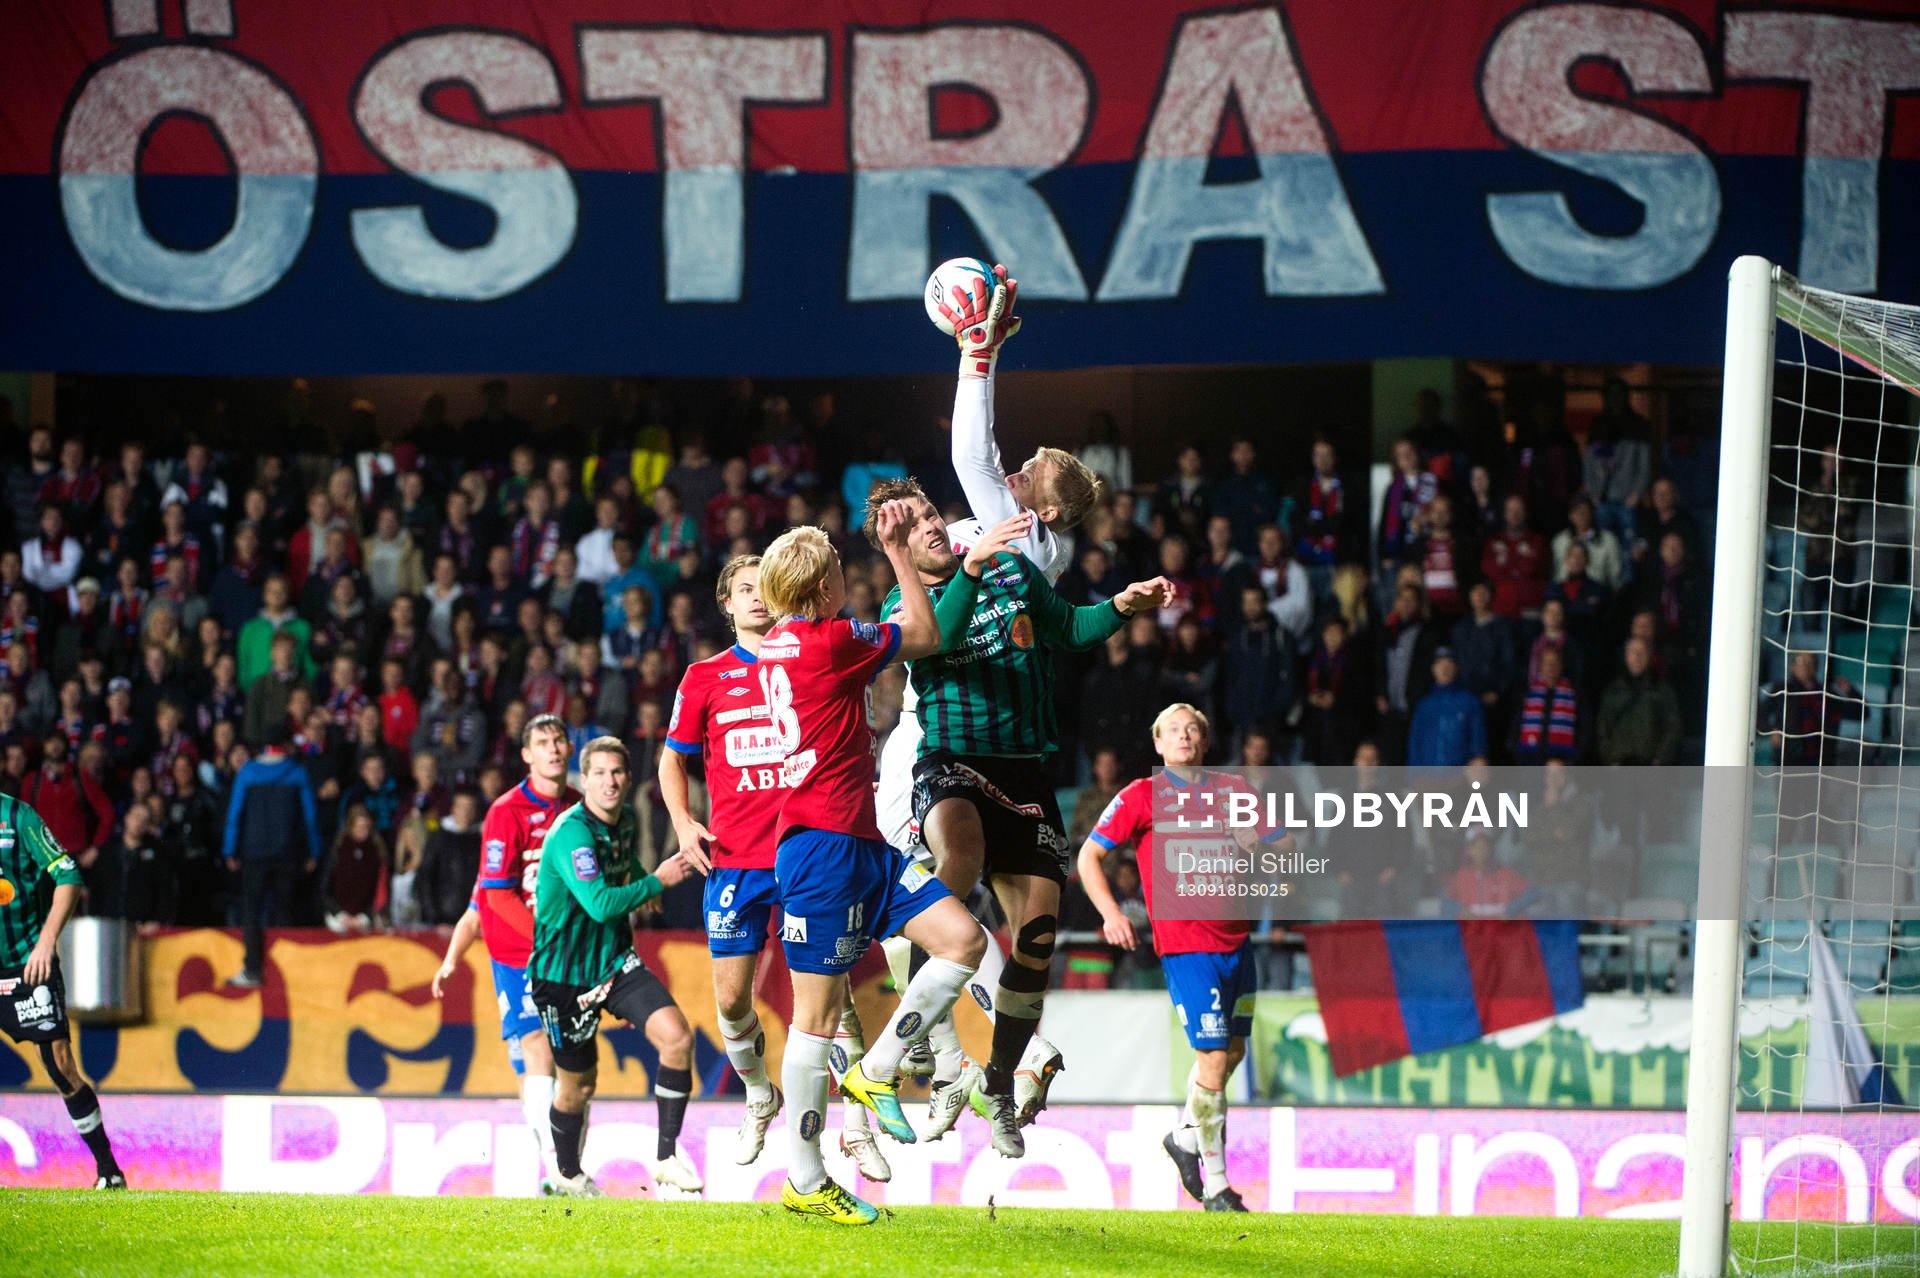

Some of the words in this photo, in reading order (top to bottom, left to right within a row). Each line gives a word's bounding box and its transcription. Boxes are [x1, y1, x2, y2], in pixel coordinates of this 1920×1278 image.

[60, 0, 1386, 311] ÖSTRA
[1483, 3, 1920, 294] ST
[759, 664, 800, 754] 18
[719, 884, 736, 908] 6
[847, 902, 863, 932] 18
[1210, 988, 1221, 1010] 2
